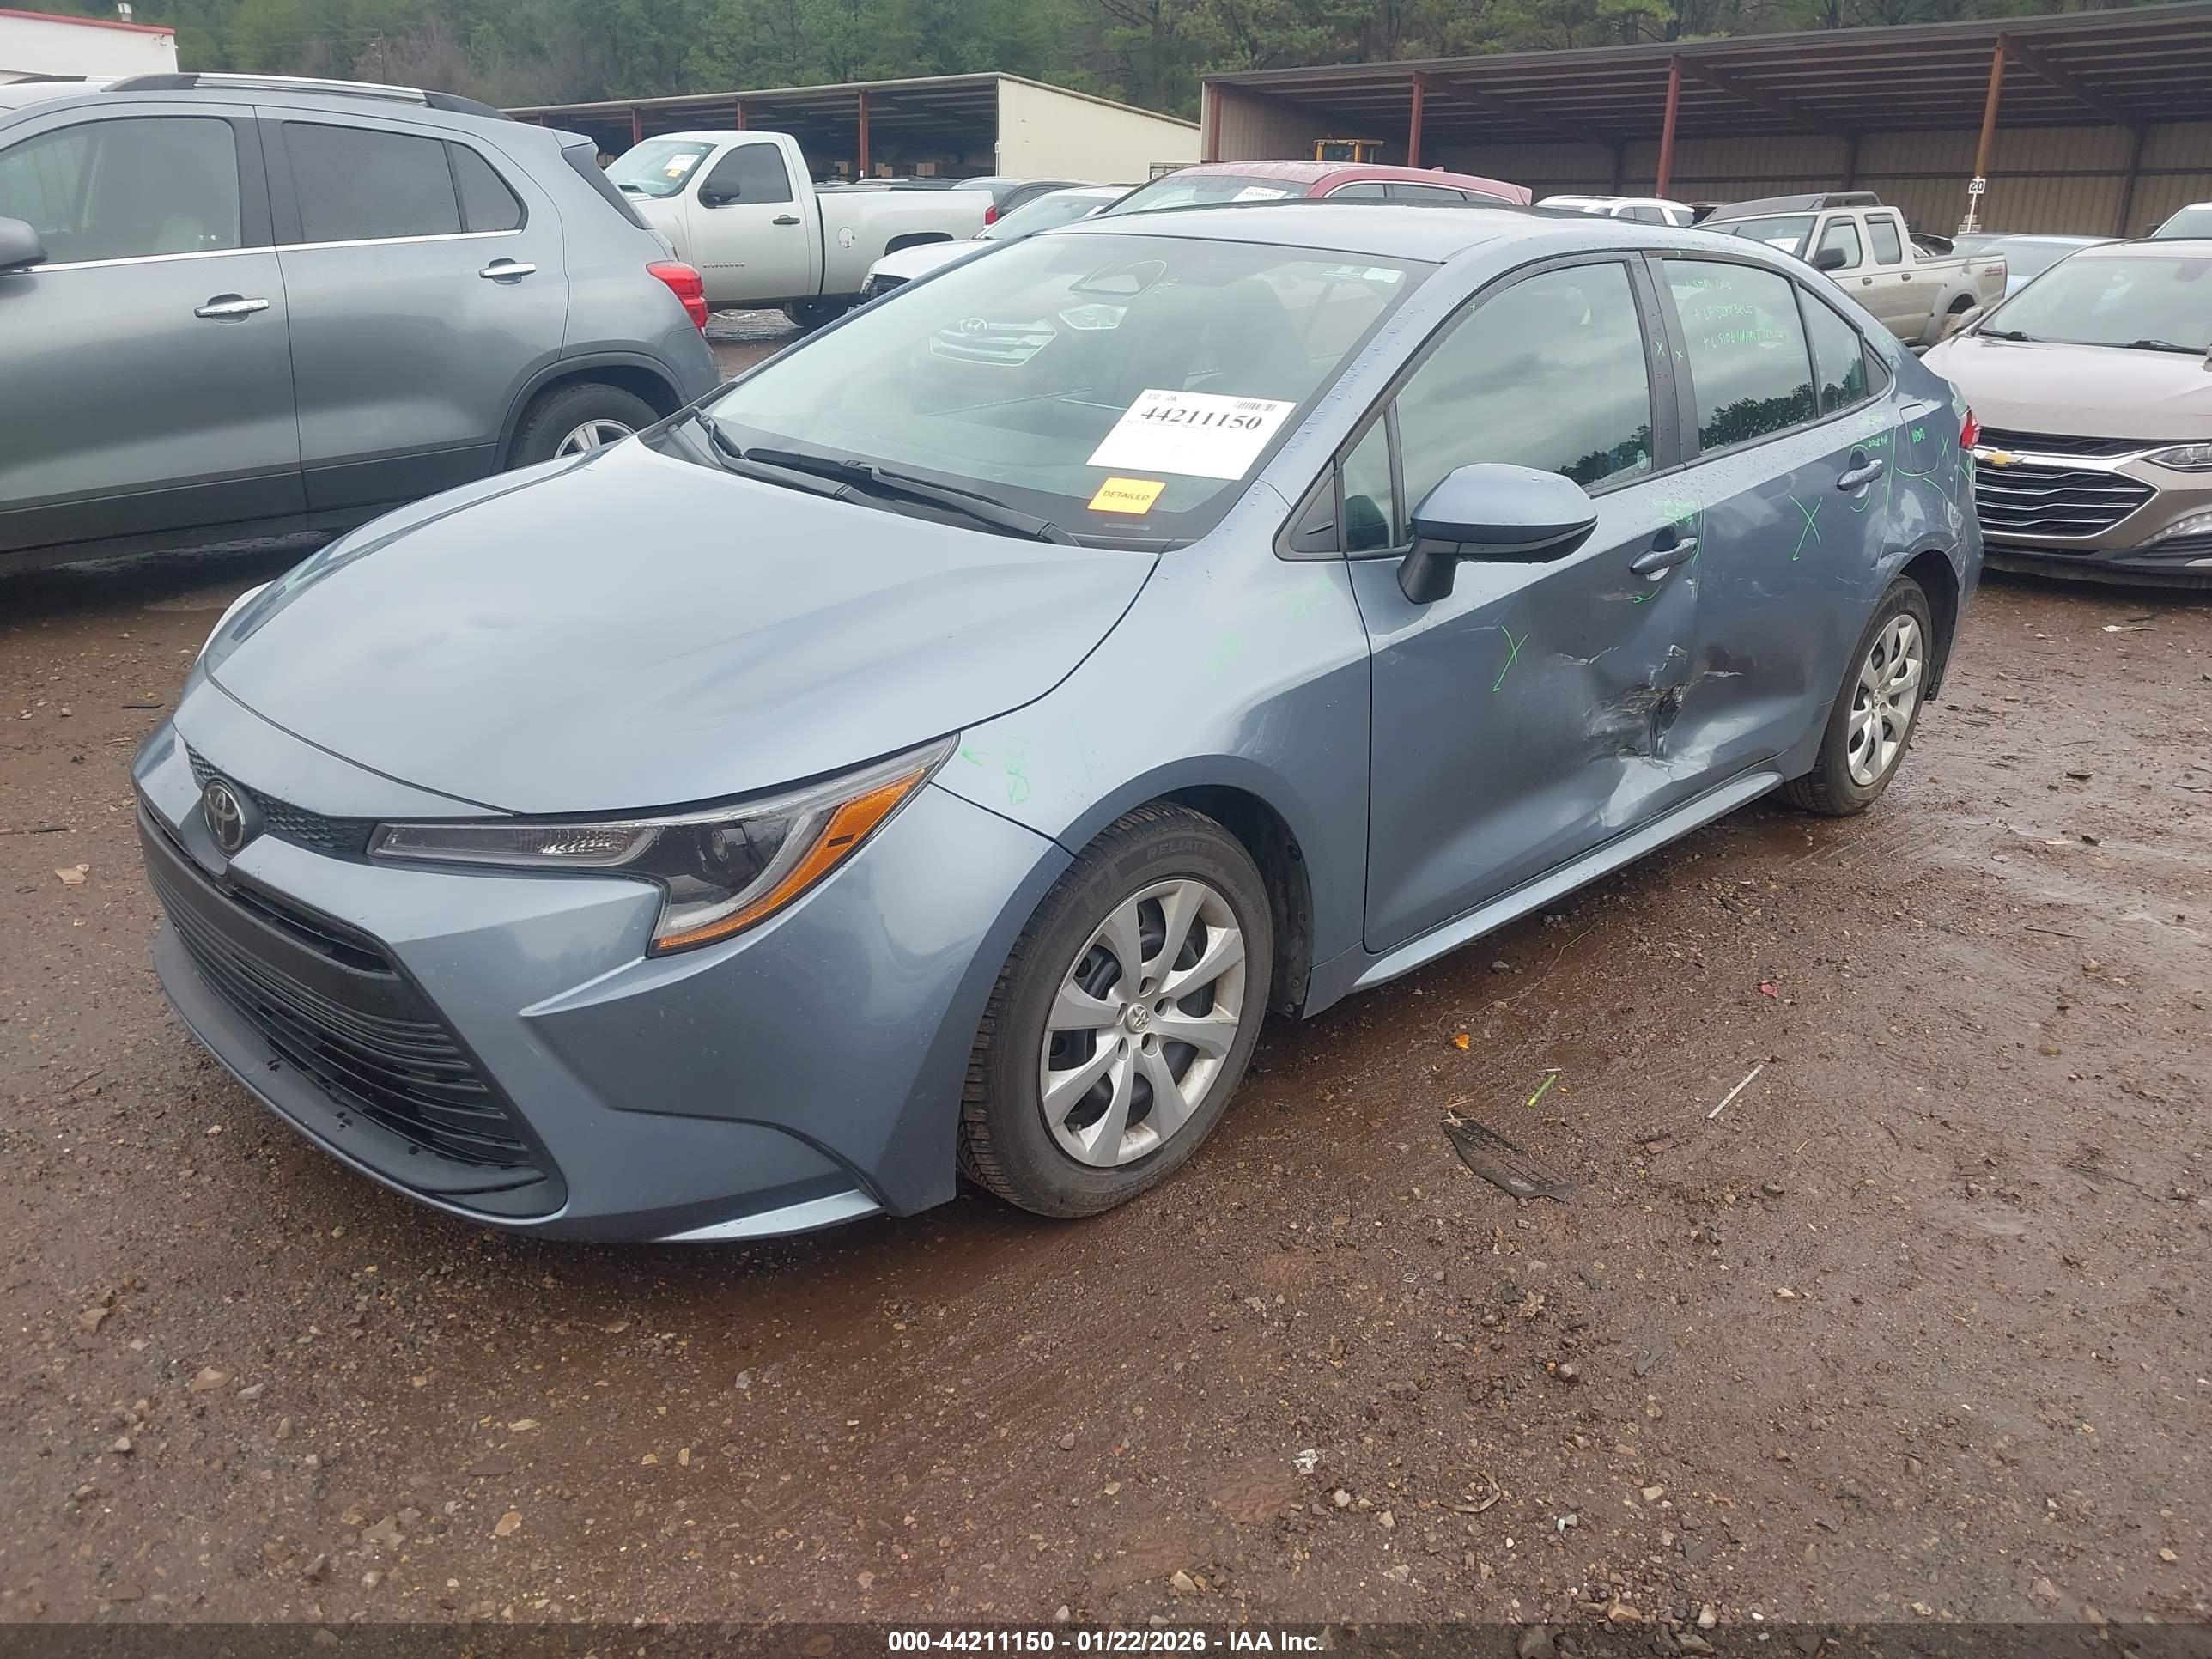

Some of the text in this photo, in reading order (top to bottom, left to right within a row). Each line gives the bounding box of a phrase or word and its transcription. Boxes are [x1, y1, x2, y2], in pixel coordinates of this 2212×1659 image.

[1970, 180, 1984, 191] 20
[1141, 406, 1263, 430] 44211150
[1103, 490, 1151, 501] DETAILED
